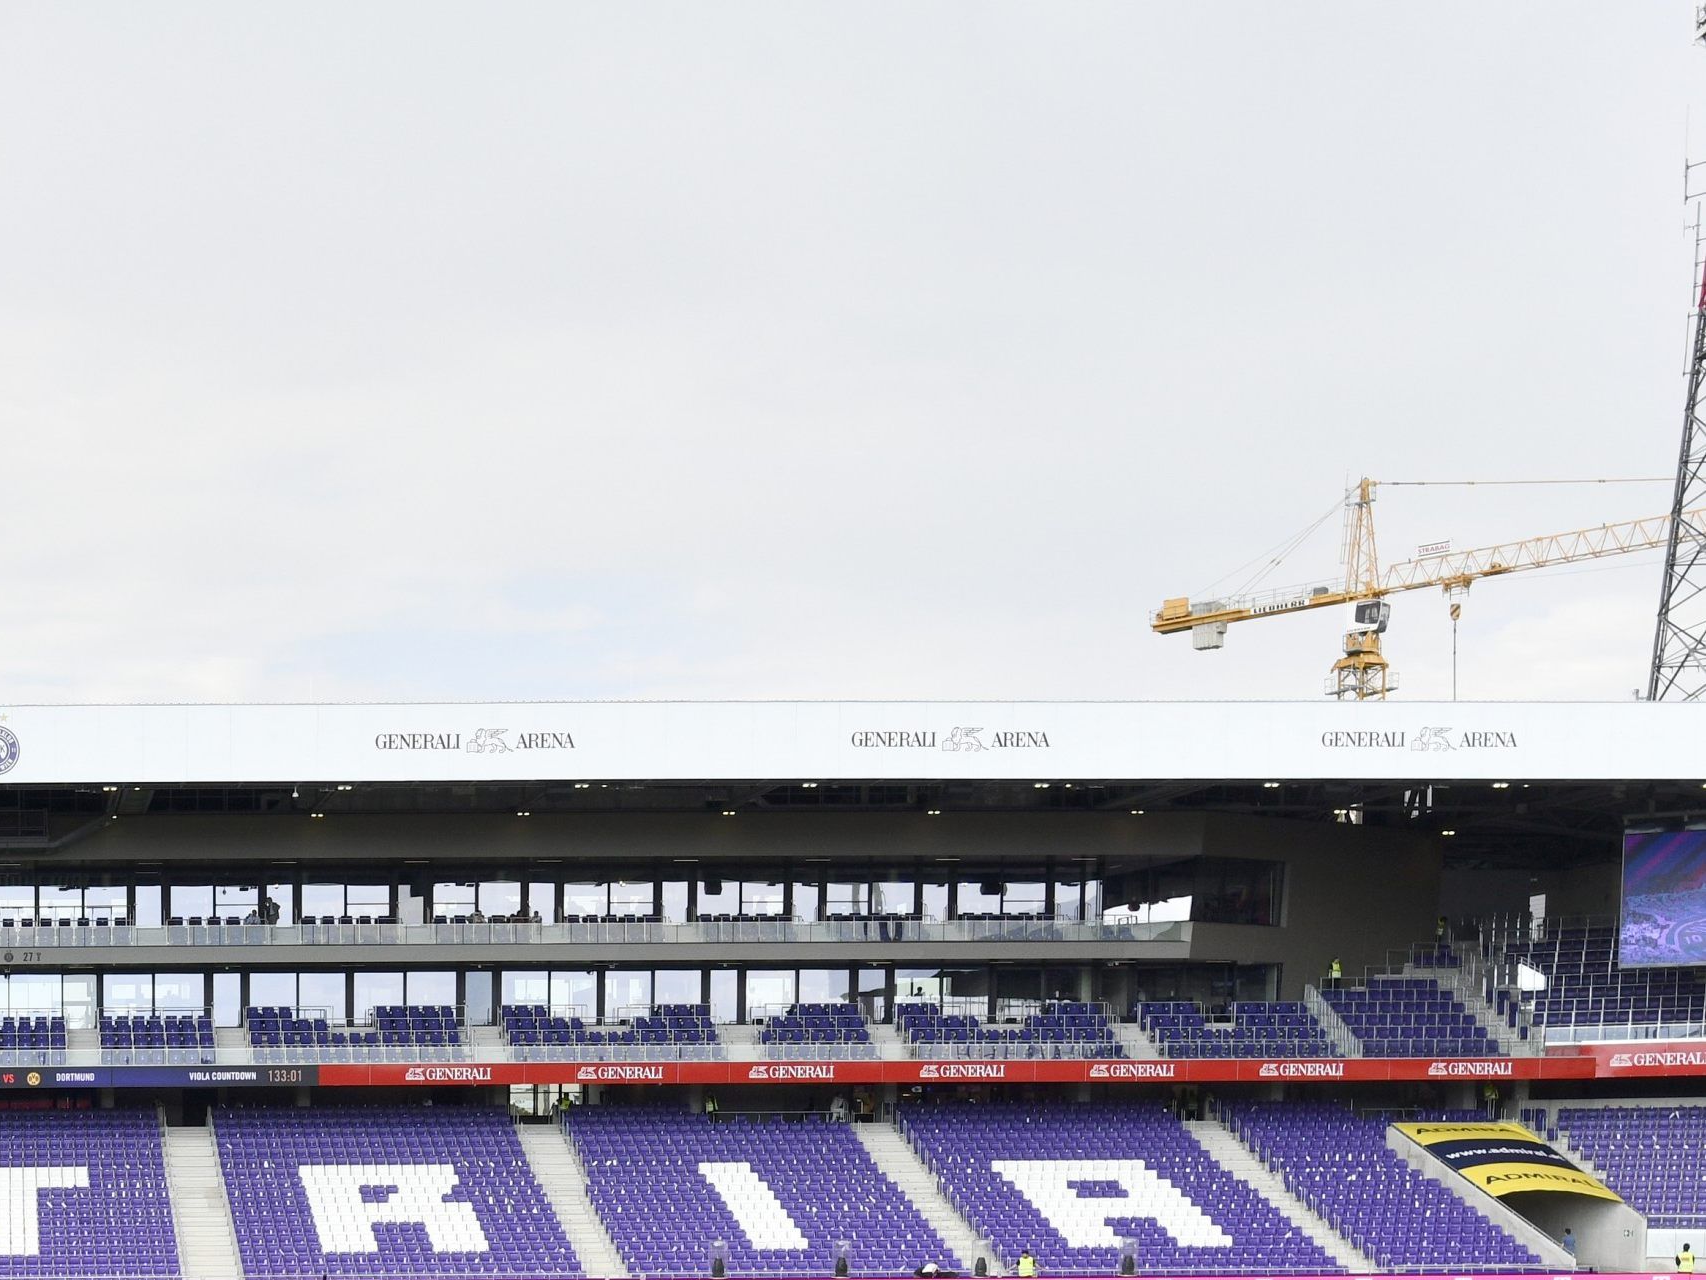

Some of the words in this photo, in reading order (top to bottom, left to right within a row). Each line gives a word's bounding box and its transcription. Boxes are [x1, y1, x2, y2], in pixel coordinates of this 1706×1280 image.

[1417, 543, 1450, 555] STRABAG
[376, 733, 461, 750] GENERALI
[516, 731, 576, 749] ARENA
[851, 731, 936, 748] GENERALI
[992, 730, 1050, 748] ARENA
[1322, 731, 1406, 748] GENERALI
[1459, 731, 1518, 748] ARENA
[23, 952, 33, 962] 27
[268, 1070, 303, 1082] 133:01
[425, 1067, 492, 1081] GENERALI
[597, 1066, 663, 1080] GENERALI
[768, 1065, 835, 1079] GENERALI
[940, 1064, 1005, 1078] GENERALI
[1110, 1064, 1175, 1078] GENERALI
[1279, 1063, 1344, 1077] GENERALI
[1447, 1062, 1513, 1076] GENERALI
[2, 1073, 15, 1084] VS
[56, 1072, 95, 1082] DORTMUND
[189, 1072, 211, 1082] VIOLA
[211, 1071, 257, 1081] COUNTDOWN
[1485, 1172, 1605, 1190] ADMIRAL
